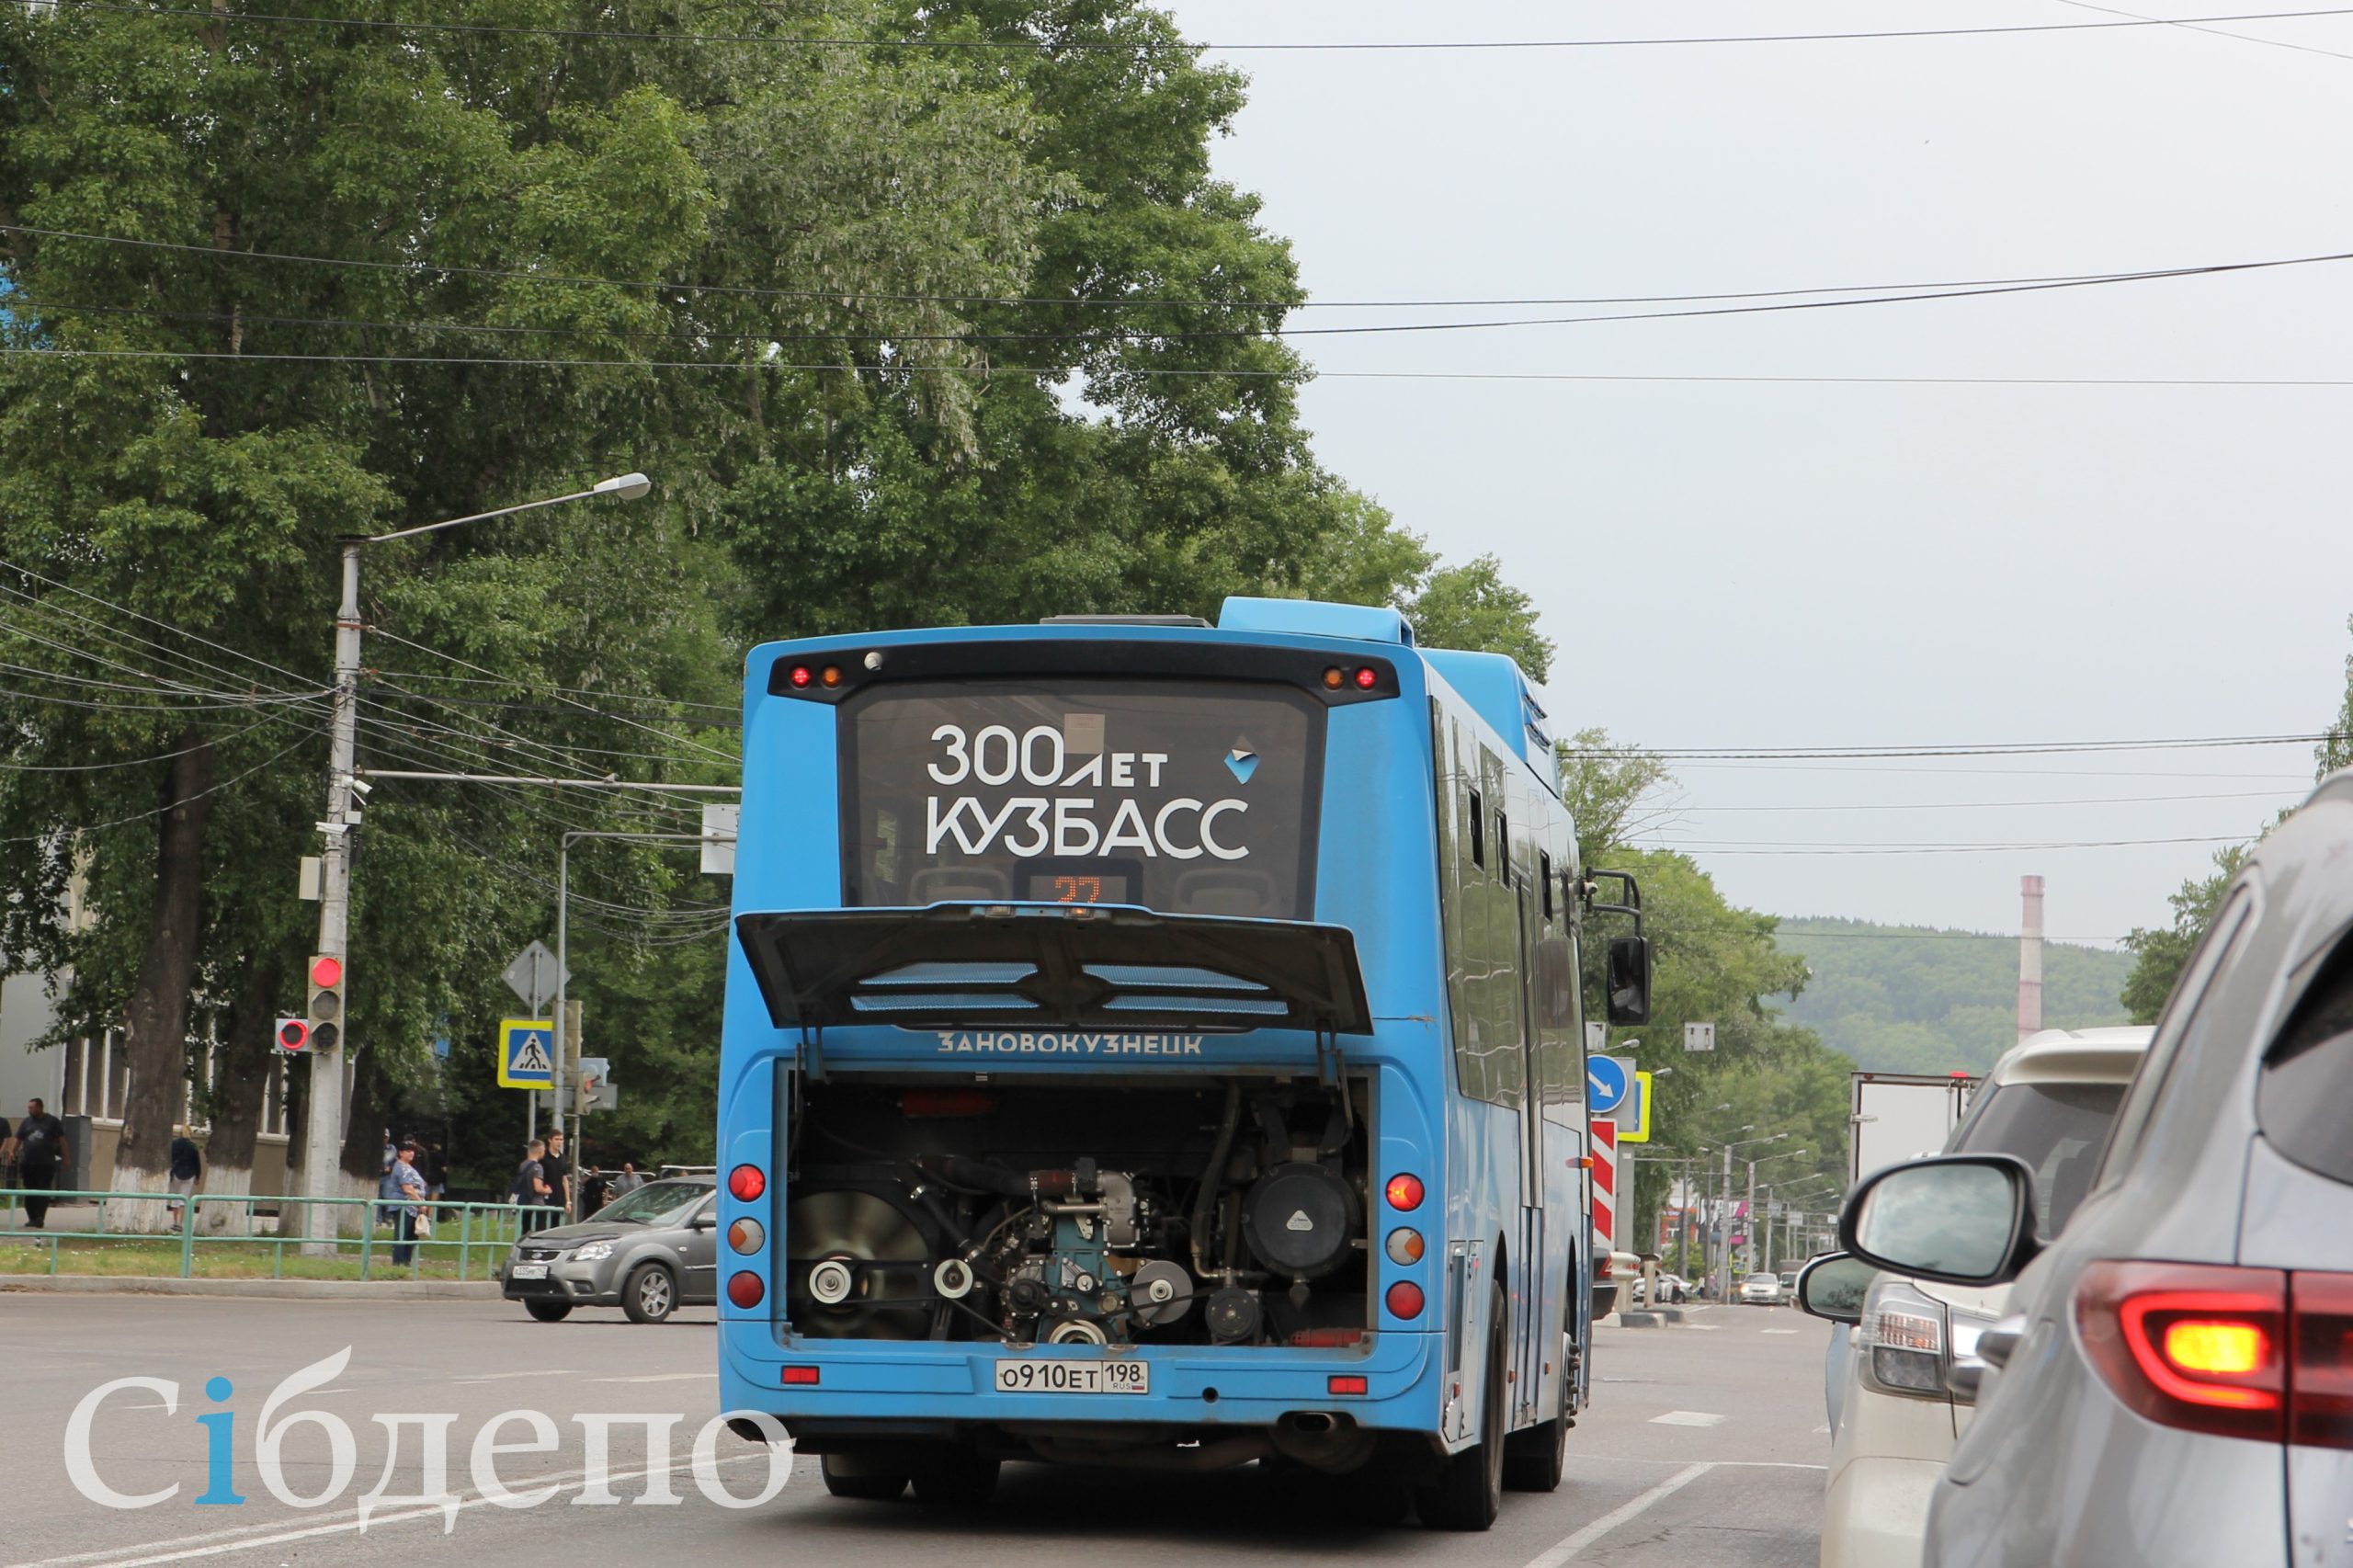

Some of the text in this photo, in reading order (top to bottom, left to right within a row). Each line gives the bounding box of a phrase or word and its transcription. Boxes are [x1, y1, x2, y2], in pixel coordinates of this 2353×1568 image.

[926, 796, 1250, 860] КУЗБАСС
[1105, 1364, 1141, 1382] 198
[1112, 1382, 1131, 1391] RUS
